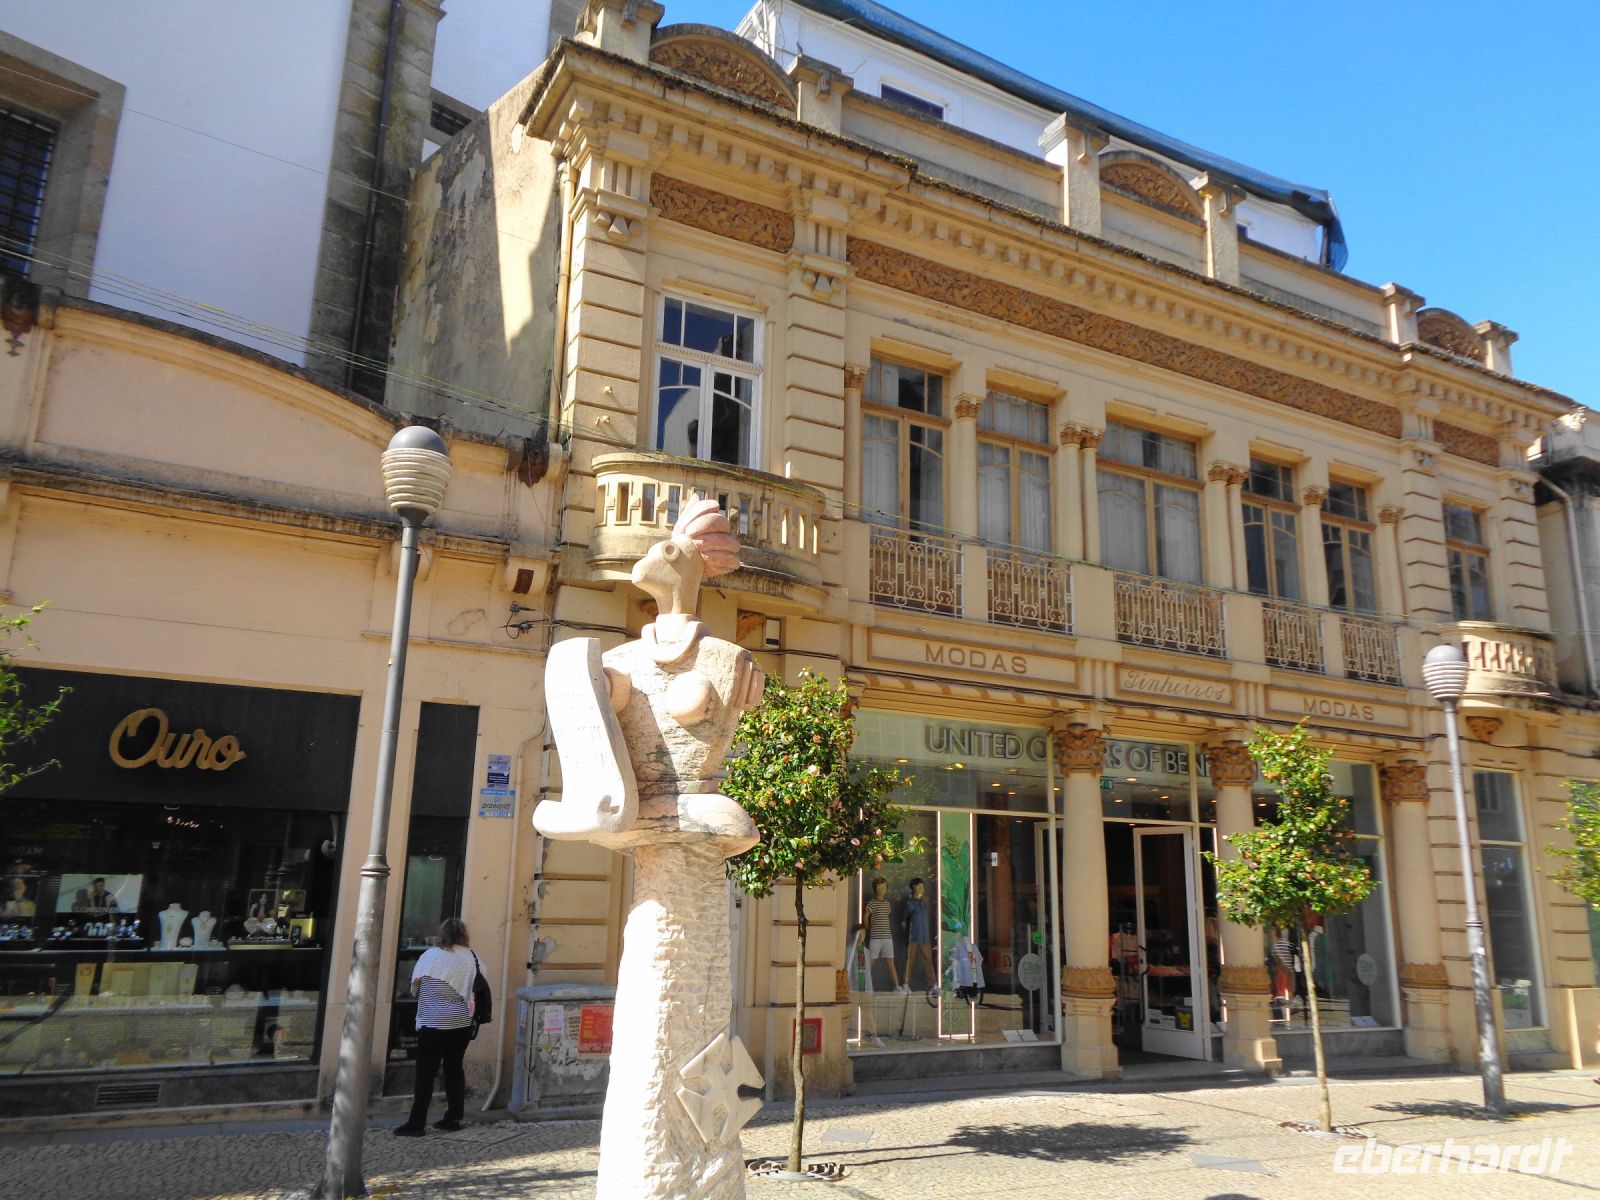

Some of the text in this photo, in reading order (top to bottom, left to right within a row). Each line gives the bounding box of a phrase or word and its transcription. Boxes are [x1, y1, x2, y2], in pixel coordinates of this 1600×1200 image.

[925, 643, 1028, 674] MODAS
[1124, 670, 1226, 700] Pinheiros
[1303, 697, 1375, 721] MODAS
[109, 707, 247, 771] Ouro
[926, 725, 1023, 760] UNITED
[1128, 746, 1160, 773] OF
